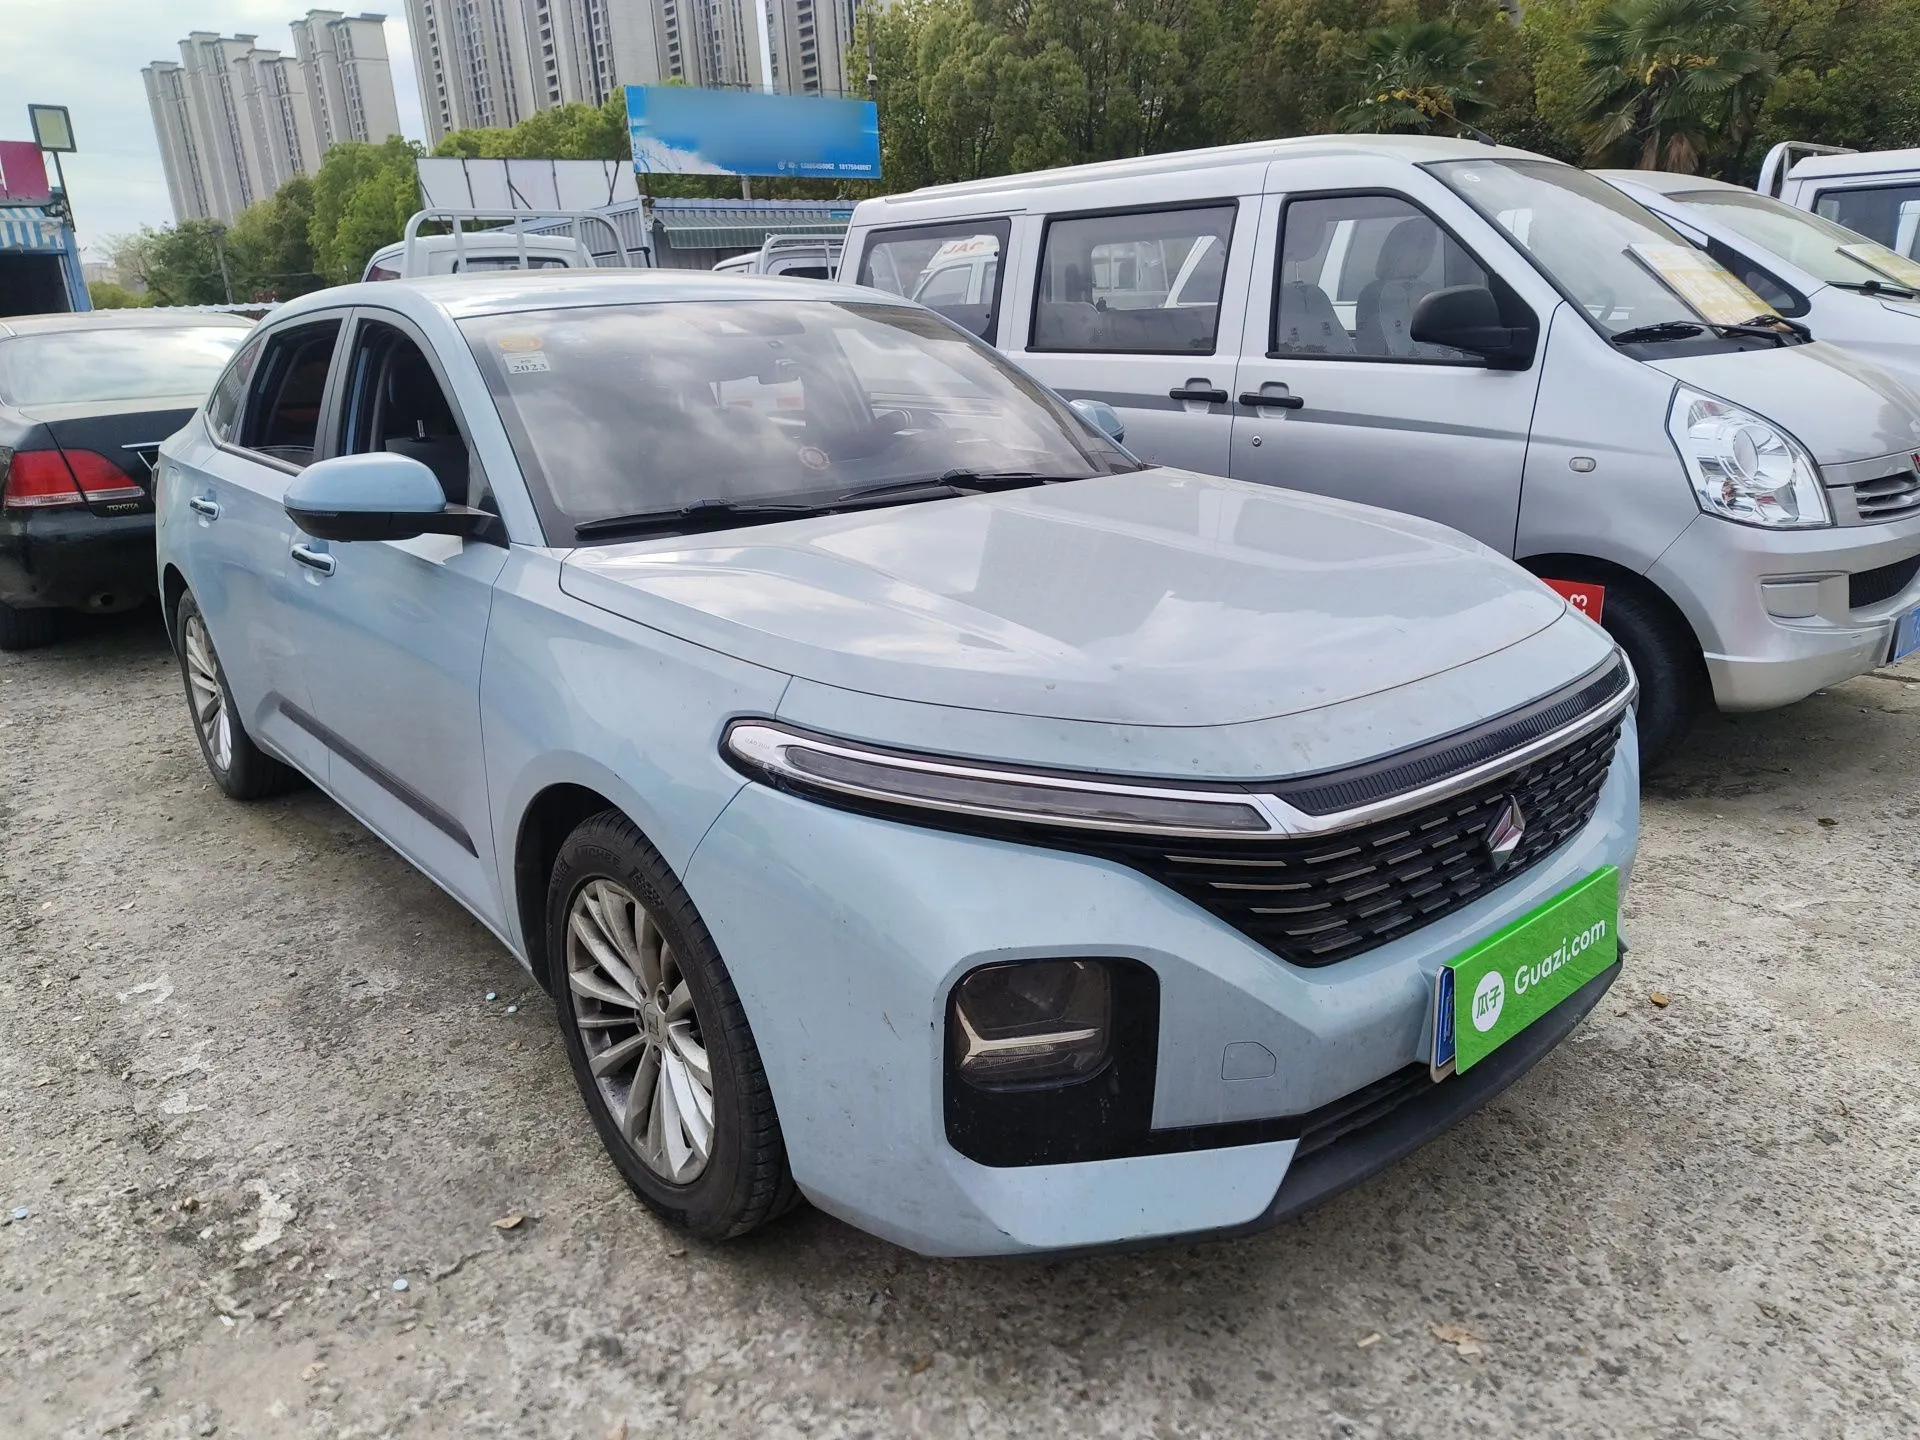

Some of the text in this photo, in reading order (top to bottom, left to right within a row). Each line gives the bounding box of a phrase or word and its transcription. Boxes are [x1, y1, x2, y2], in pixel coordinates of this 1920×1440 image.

[106, 503, 139, 511] TOYOTA
[1514, 920, 1606, 995] Guazi.com
[1476, 985, 1501, 1019] 瓜子
